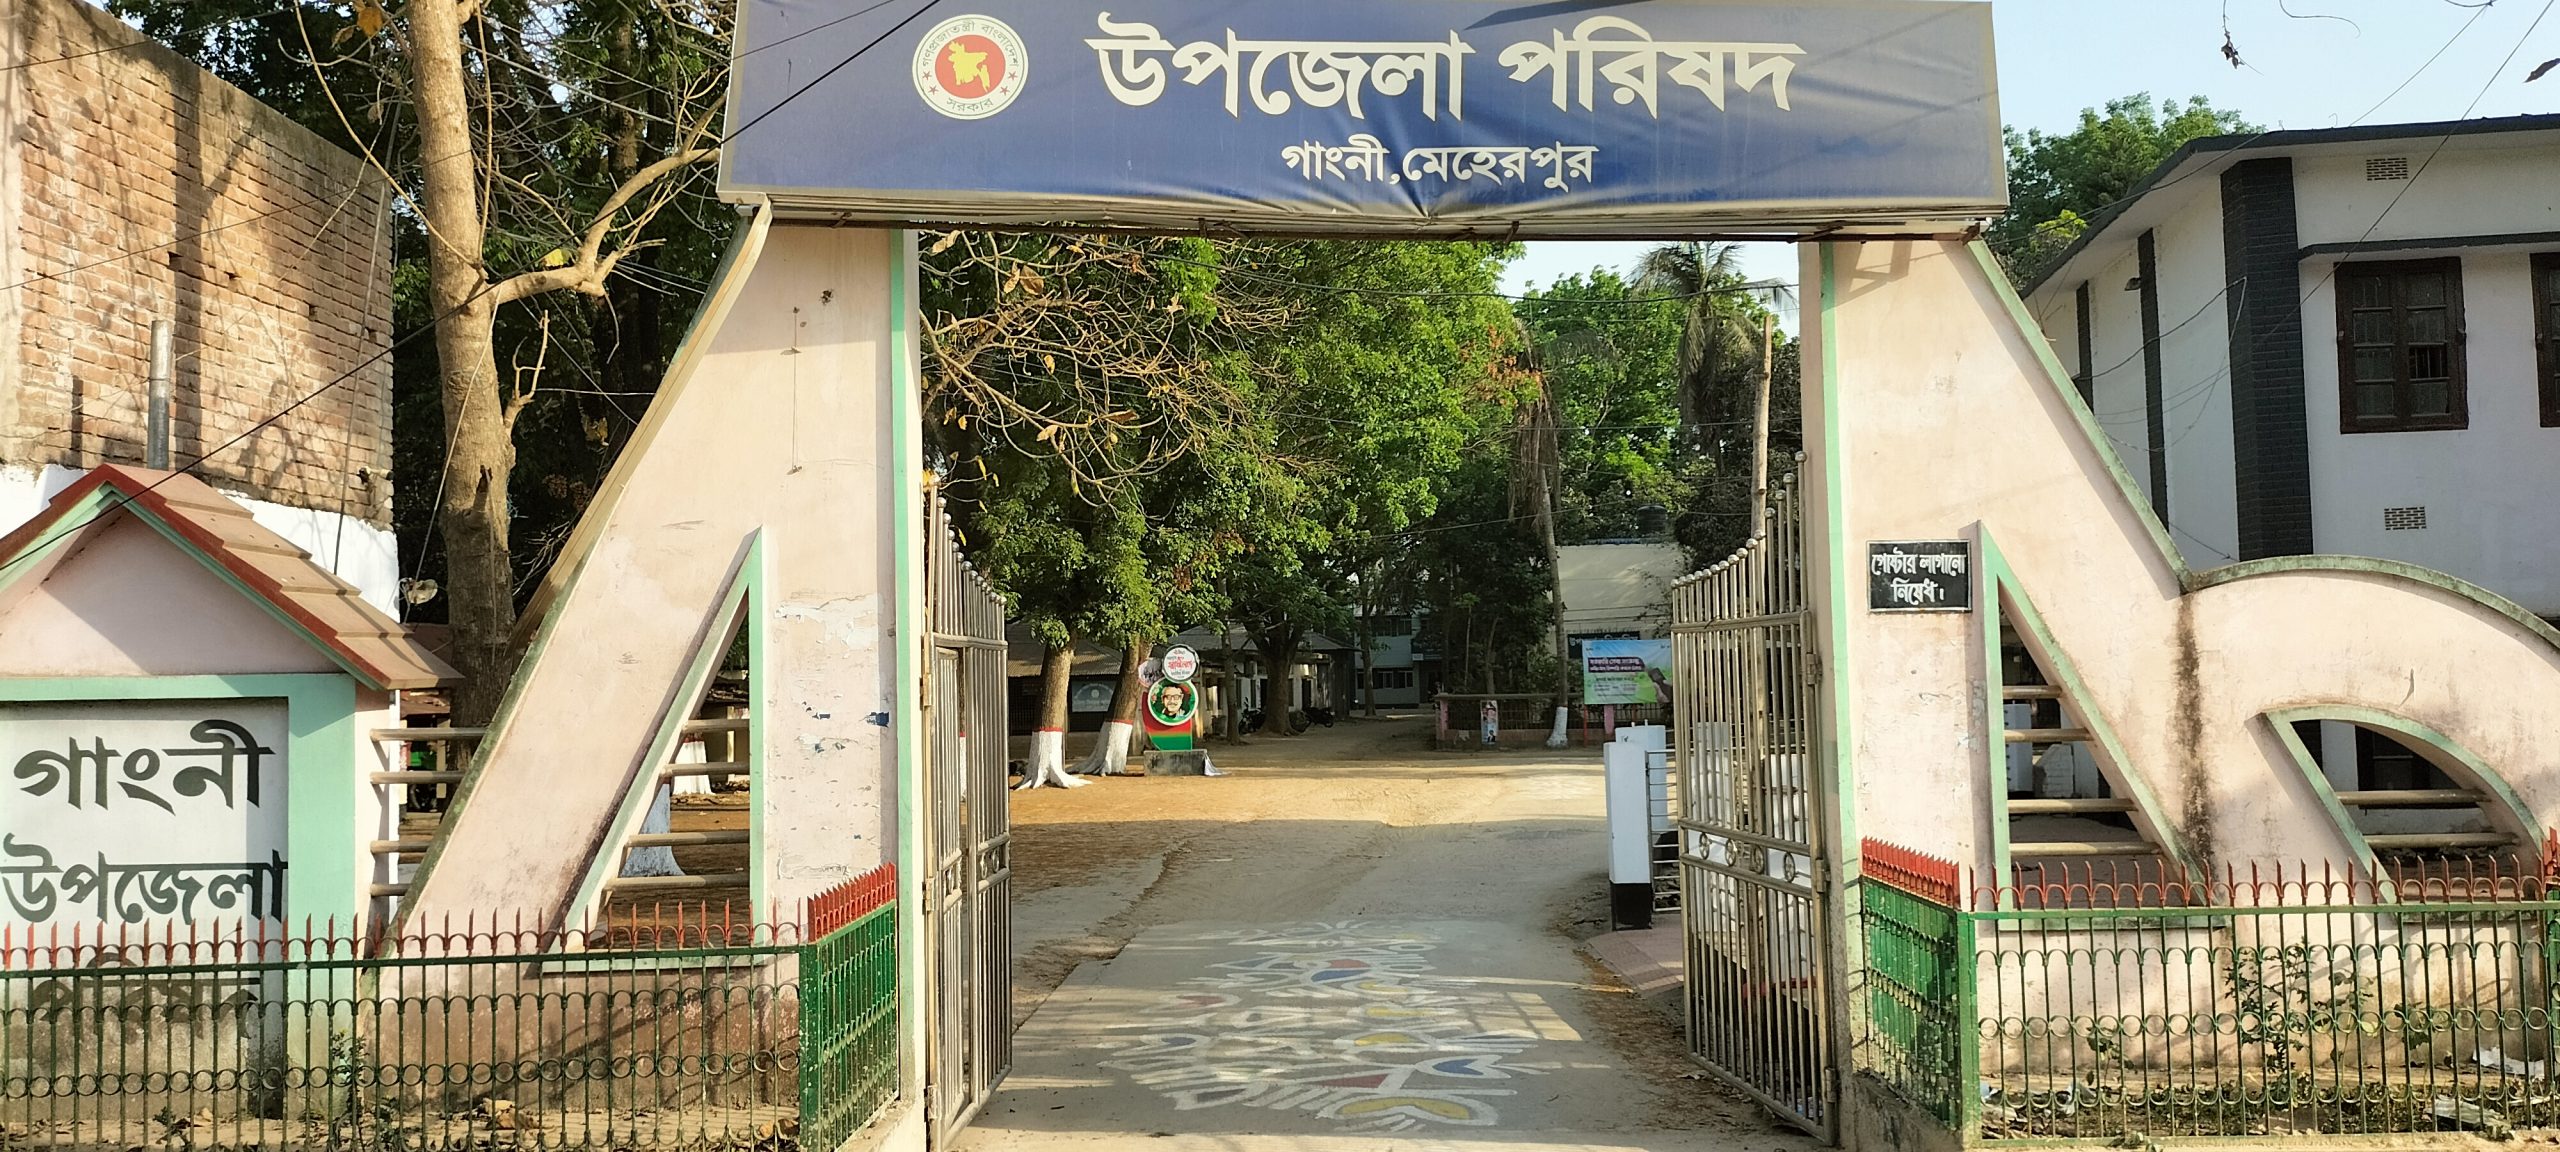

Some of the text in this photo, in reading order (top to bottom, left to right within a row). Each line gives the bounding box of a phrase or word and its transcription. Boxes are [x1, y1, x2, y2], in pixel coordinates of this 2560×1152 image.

[981, 23, 1019, 67] বাংলাদেশ
[1084, 12, 1806, 121] উপজেলা পরিষদ
[946, 97, 994, 112] সরকার
[1919, 553, 1966, 576] লাগানো
[14, 719, 275, 815] গাংনী
[0, 833, 289, 926] উপজেলা
